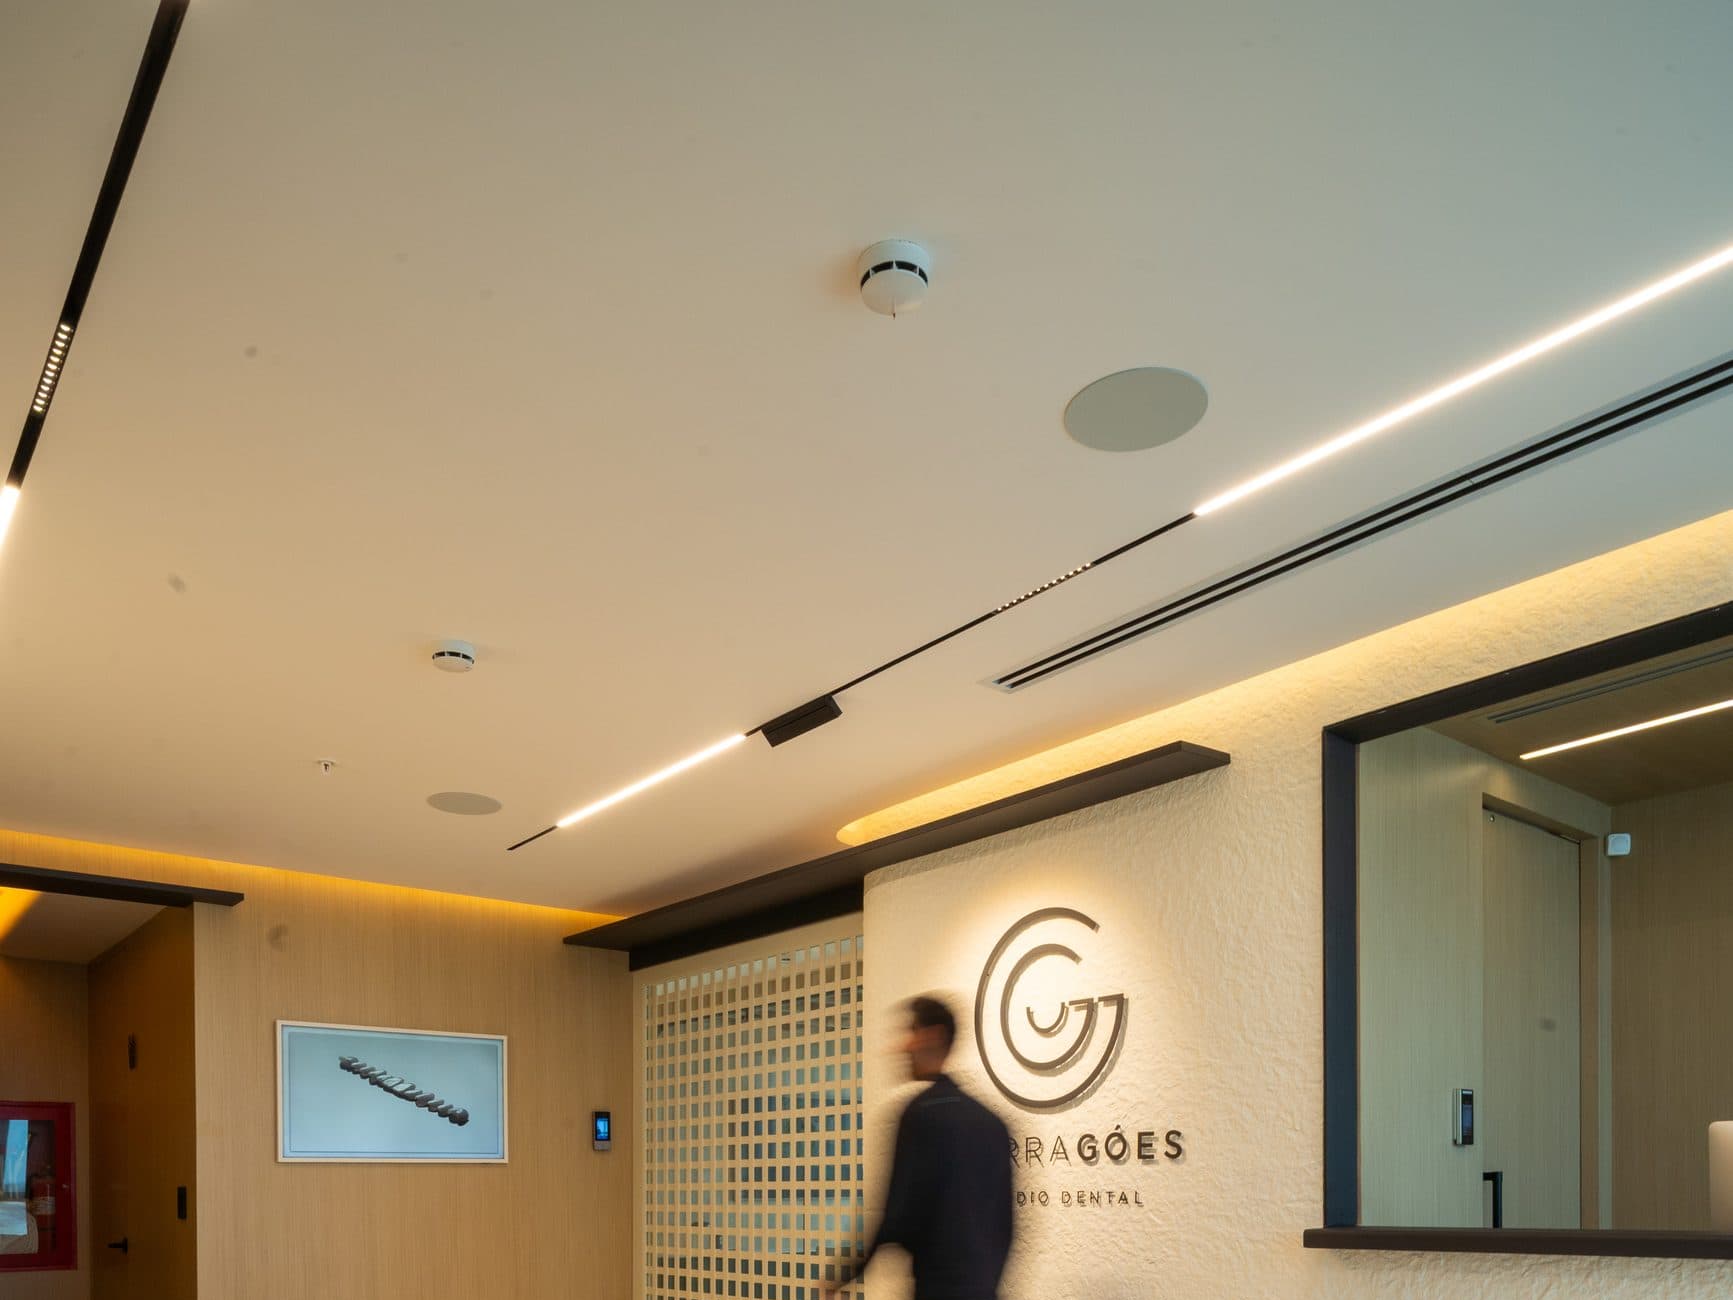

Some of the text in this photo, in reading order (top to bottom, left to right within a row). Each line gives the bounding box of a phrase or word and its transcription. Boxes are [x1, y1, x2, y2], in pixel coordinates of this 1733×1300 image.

[1008, 1124, 1183, 1165] RRAGÓES
[1016, 1190, 1144, 1206] DIO DENTAL
